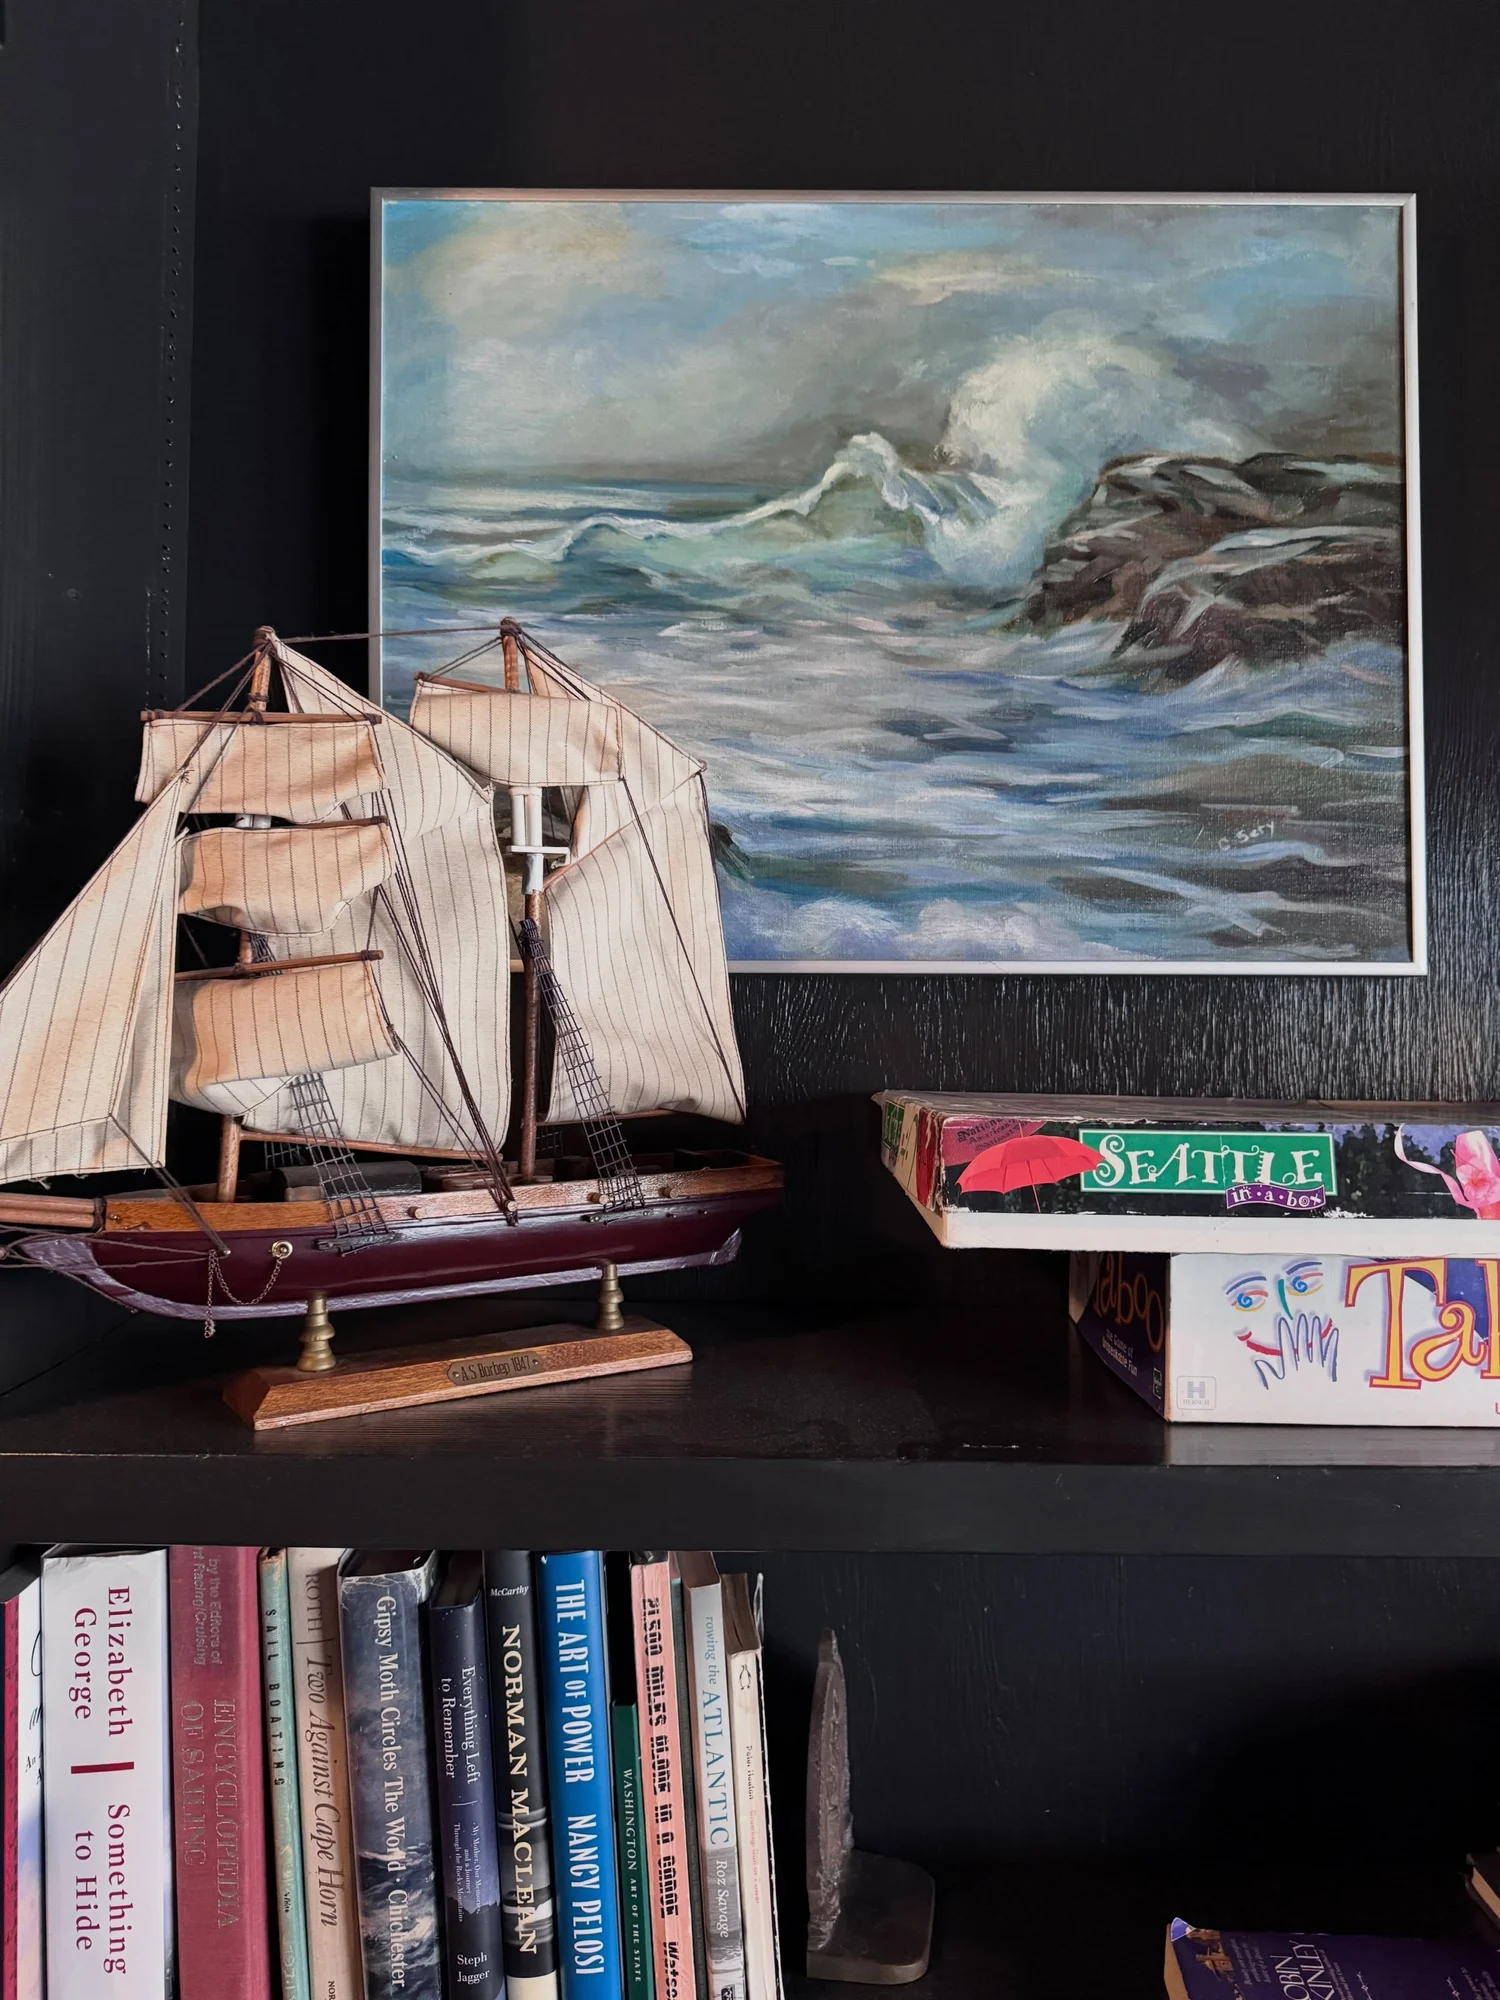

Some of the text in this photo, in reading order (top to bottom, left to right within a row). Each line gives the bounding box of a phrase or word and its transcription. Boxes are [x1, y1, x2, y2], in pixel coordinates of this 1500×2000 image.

[1092, 1133, 1324, 1187] SEATTLE
[510, 1355, 531, 1372] 1847
[306, 1572, 322, 1634] ROTH
[489, 1584, 529, 1598] McCarthy
[69, 1607, 98, 1720] George
[107, 1586, 132, 1737] Elizabeth
[265, 1608, 286, 1787] SAIL BOATING
[555, 1579, 594, 1785] THE ART OF POWER
[181, 1699, 207, 1866] OF SAILING
[373, 1595, 406, 1873] Gipsy Moth Circles The World
[441, 1677, 455, 1778] to Remember
[460, 1664, 478, 1785] Everything Left
[702, 1615, 730, 1845] rowing the ATLANTIC
[211, 1698, 240, 1929] ENCYCLOPEDIA
[304, 1655, 346, 1928] Two Against Cape Horn
[502, 1624, 537, 1954] NORMAN MACLEAN
[623, 1769, 637, 1871] WASHINGTON
[75, 1830, 100, 1951] to Hide
[104, 1804, 132, 1974] Something
[387, 1889, 407, 1988] Chichester
[567, 1813, 605, 1976] NANCY PELOSI
[630, 1877, 638, 1899] ART
[631, 1904, 638, 1919] OF
[714, 1859, 729, 1939] Roz Savage
[457, 1952, 488, 1968] Steph
[457, 1968, 490, 1984] Jagger
